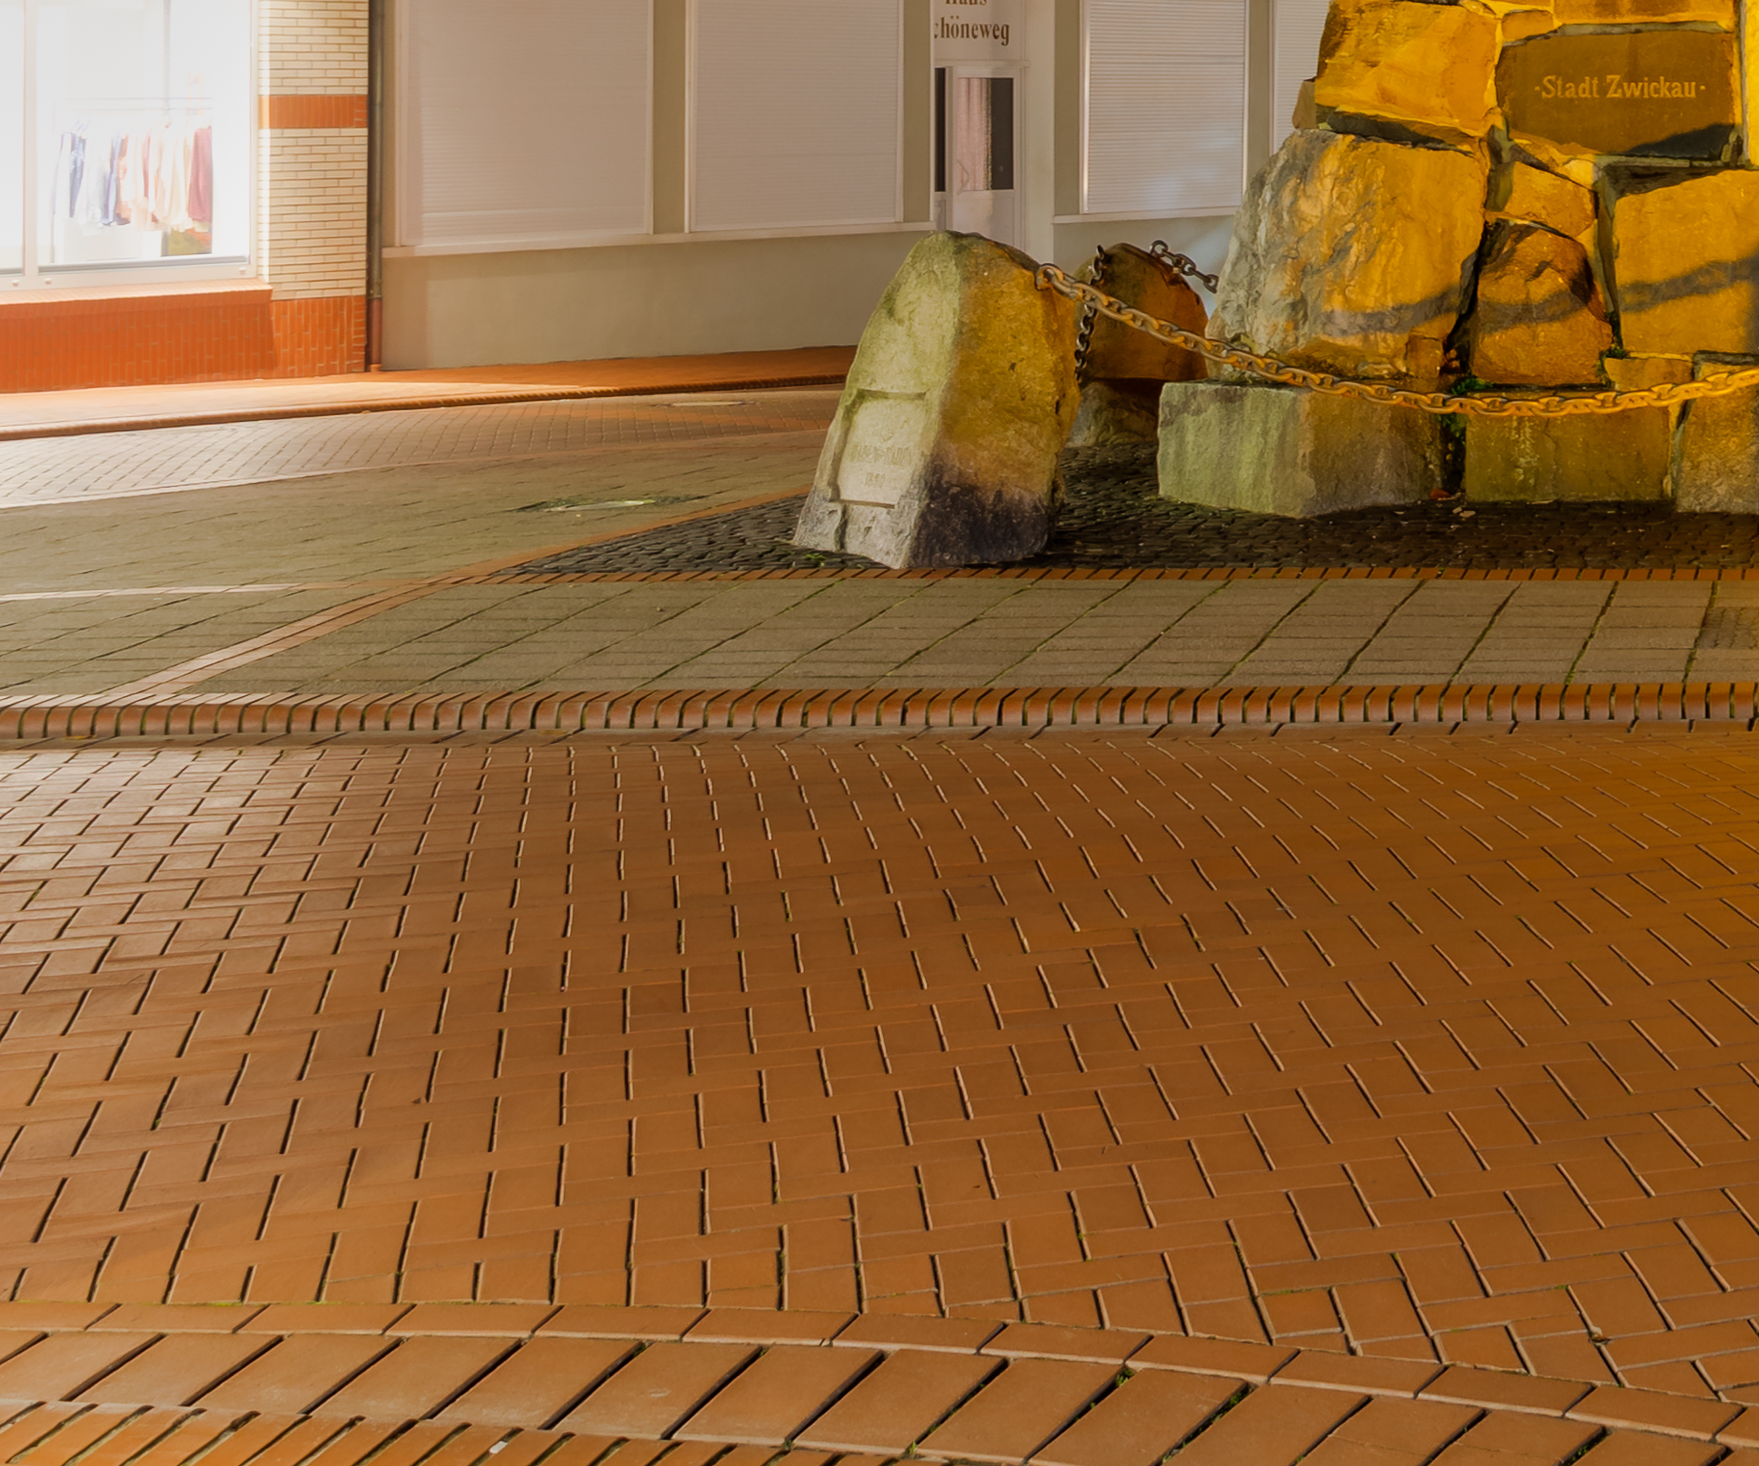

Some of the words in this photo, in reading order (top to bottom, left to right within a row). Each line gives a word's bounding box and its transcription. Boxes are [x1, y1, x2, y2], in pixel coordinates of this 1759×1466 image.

[934, 14, 1011, 47] chöneweg
[1541, 73, 1600, 99] Stadt
[1605, 74, 1697, 100] Zwickau
